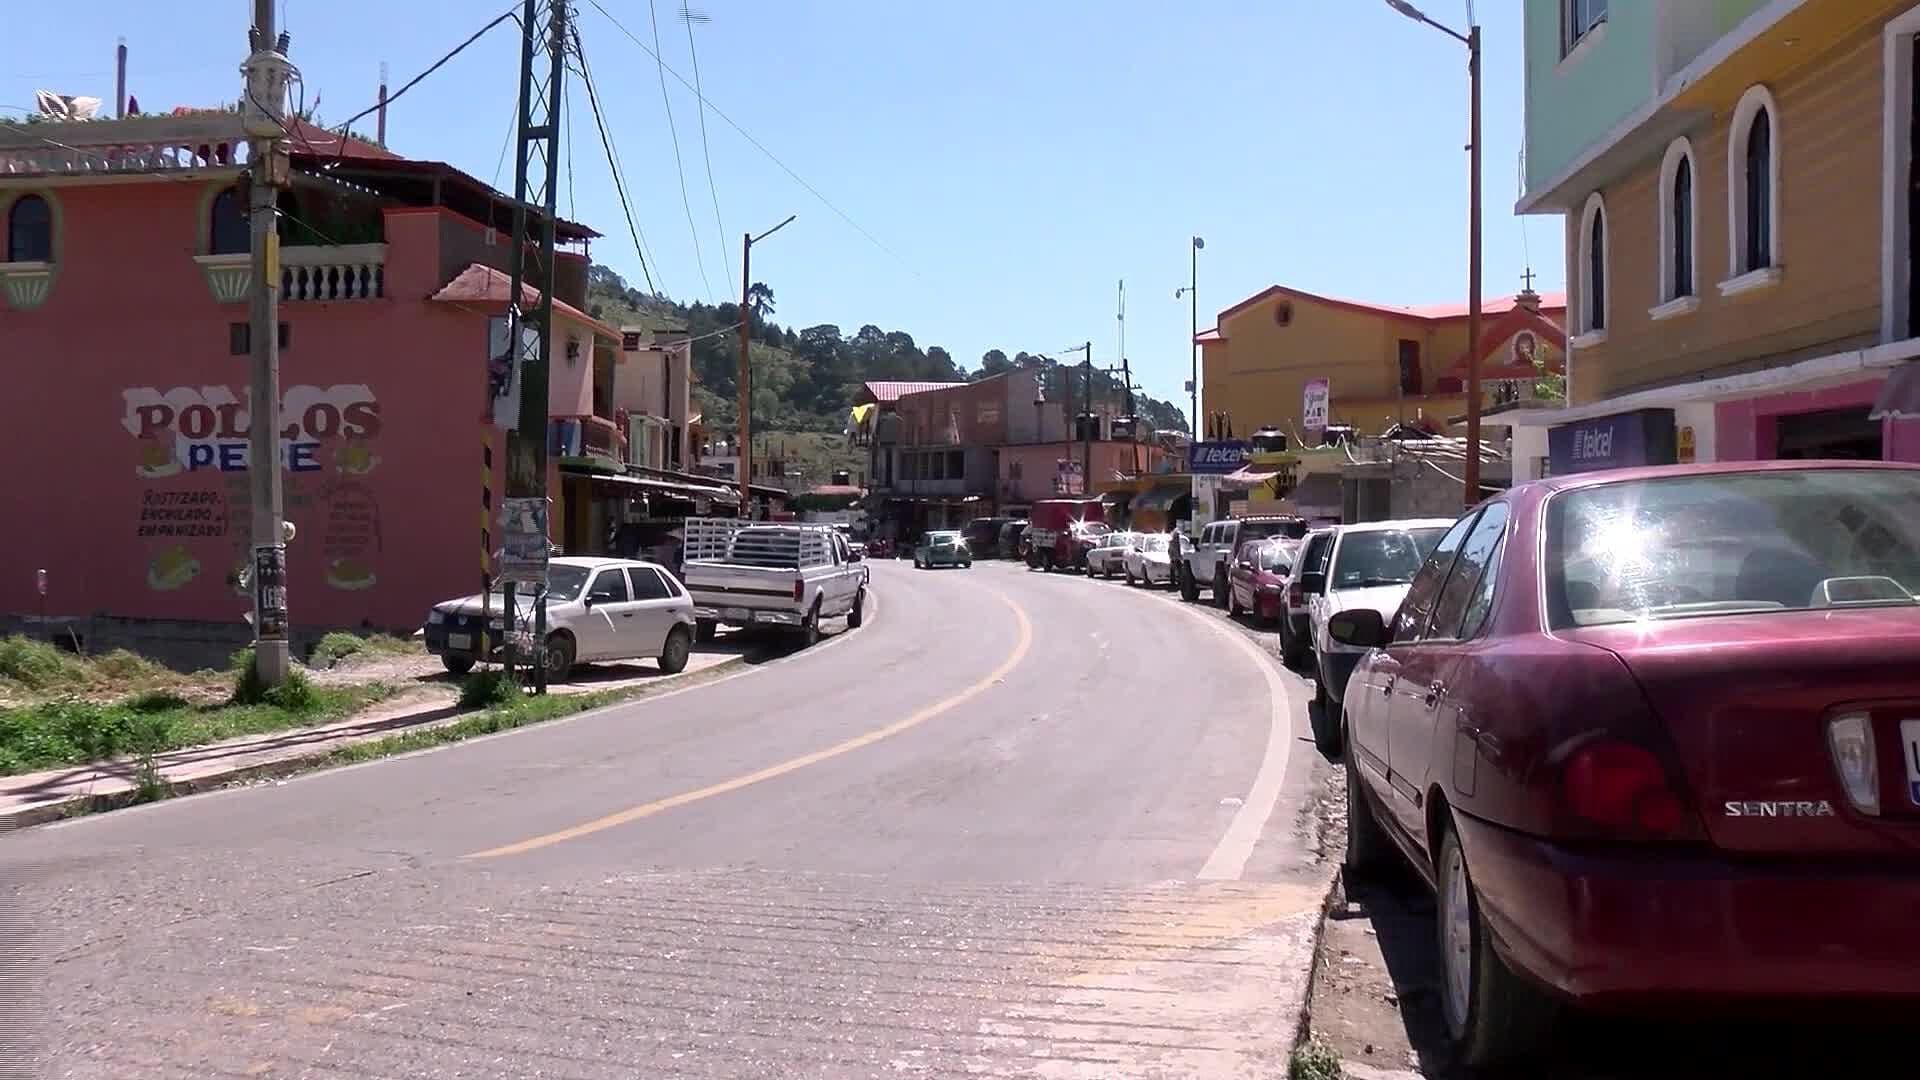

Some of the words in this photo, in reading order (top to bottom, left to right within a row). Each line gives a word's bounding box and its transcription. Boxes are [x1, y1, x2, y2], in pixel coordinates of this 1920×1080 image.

[1583, 424, 1613, 458] telcel
[189, 443, 321, 471] PEE
[1724, 800, 1835, 817] SENTRA
